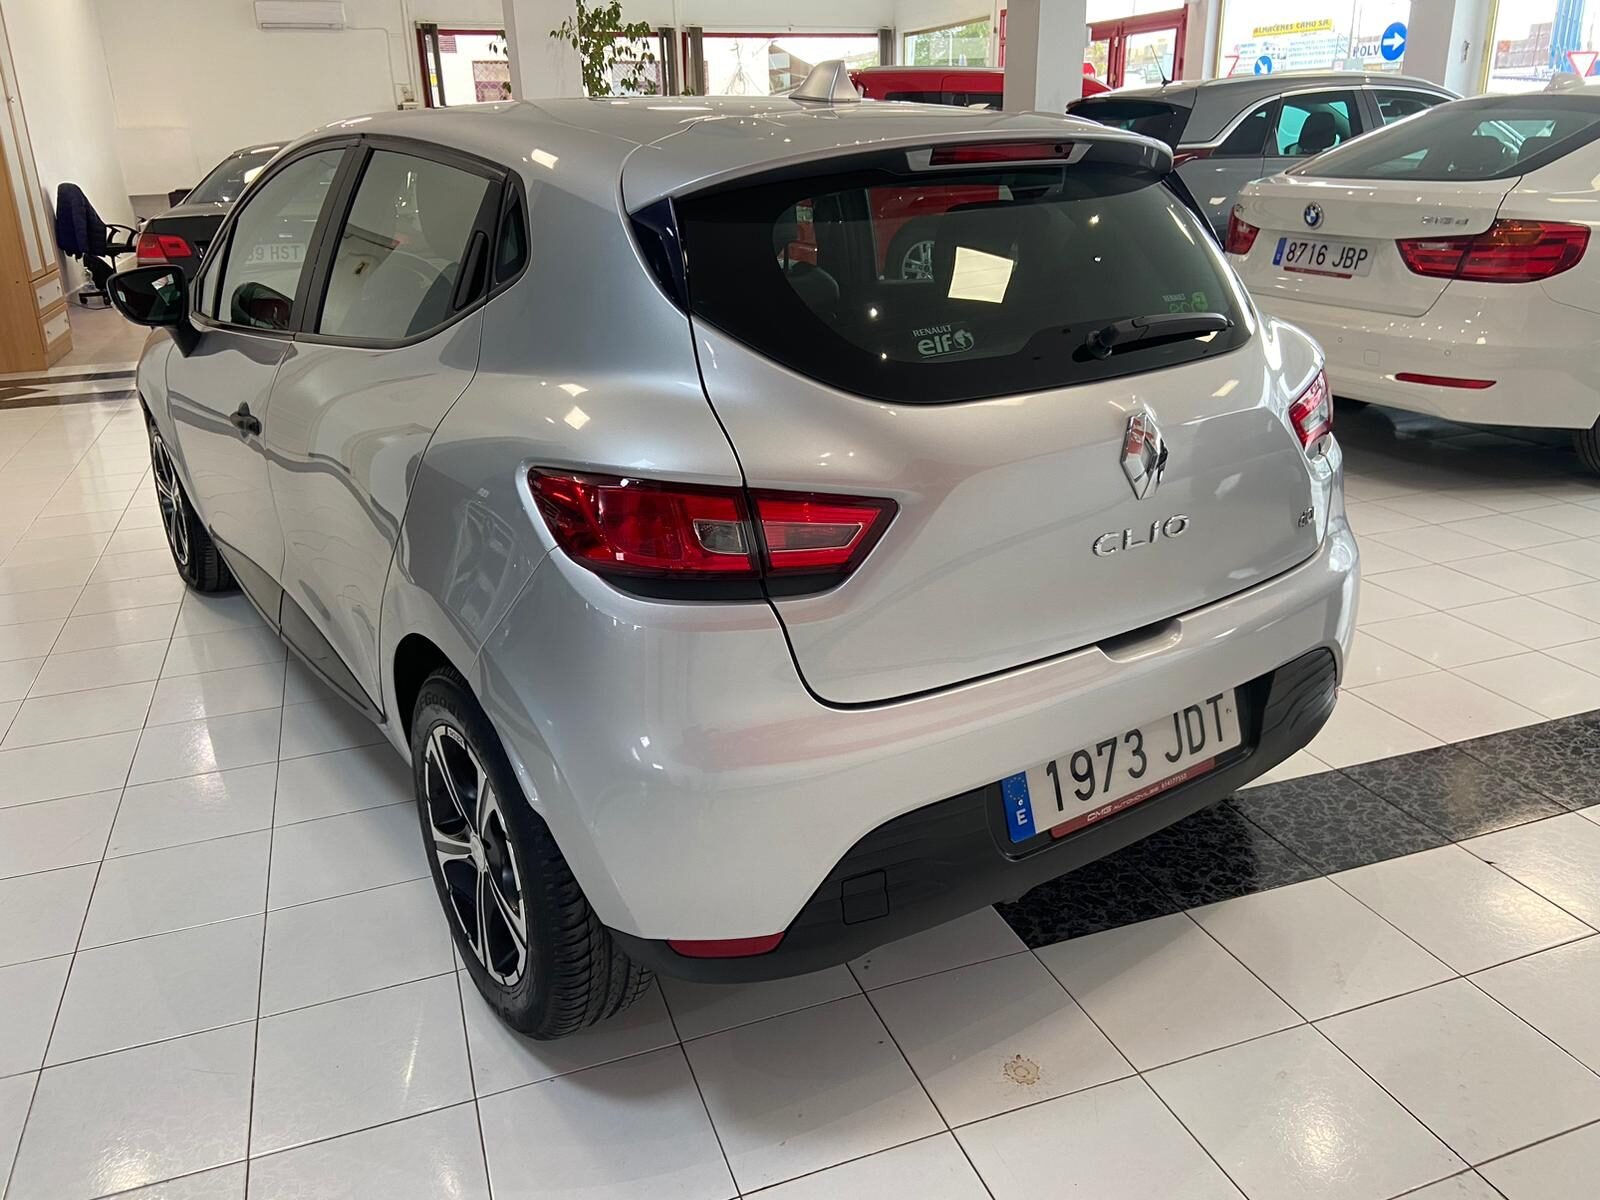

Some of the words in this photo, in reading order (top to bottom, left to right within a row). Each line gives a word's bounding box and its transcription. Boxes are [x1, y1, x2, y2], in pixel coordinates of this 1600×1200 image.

[270, 245, 300, 260] HST
[1286, 242, 1328, 266] 8716
[1332, 246, 1368, 271] JBP
[912, 325, 952, 337] RENAULT
[918, 333, 953, 355] elf
[1092, 513, 1191, 557] CLIO
[1046, 728, 1148, 812] 1973
[1164, 693, 1224, 763] JDT
[1016, 809, 1028, 826] E
[1087, 805, 1113, 822] CMG
